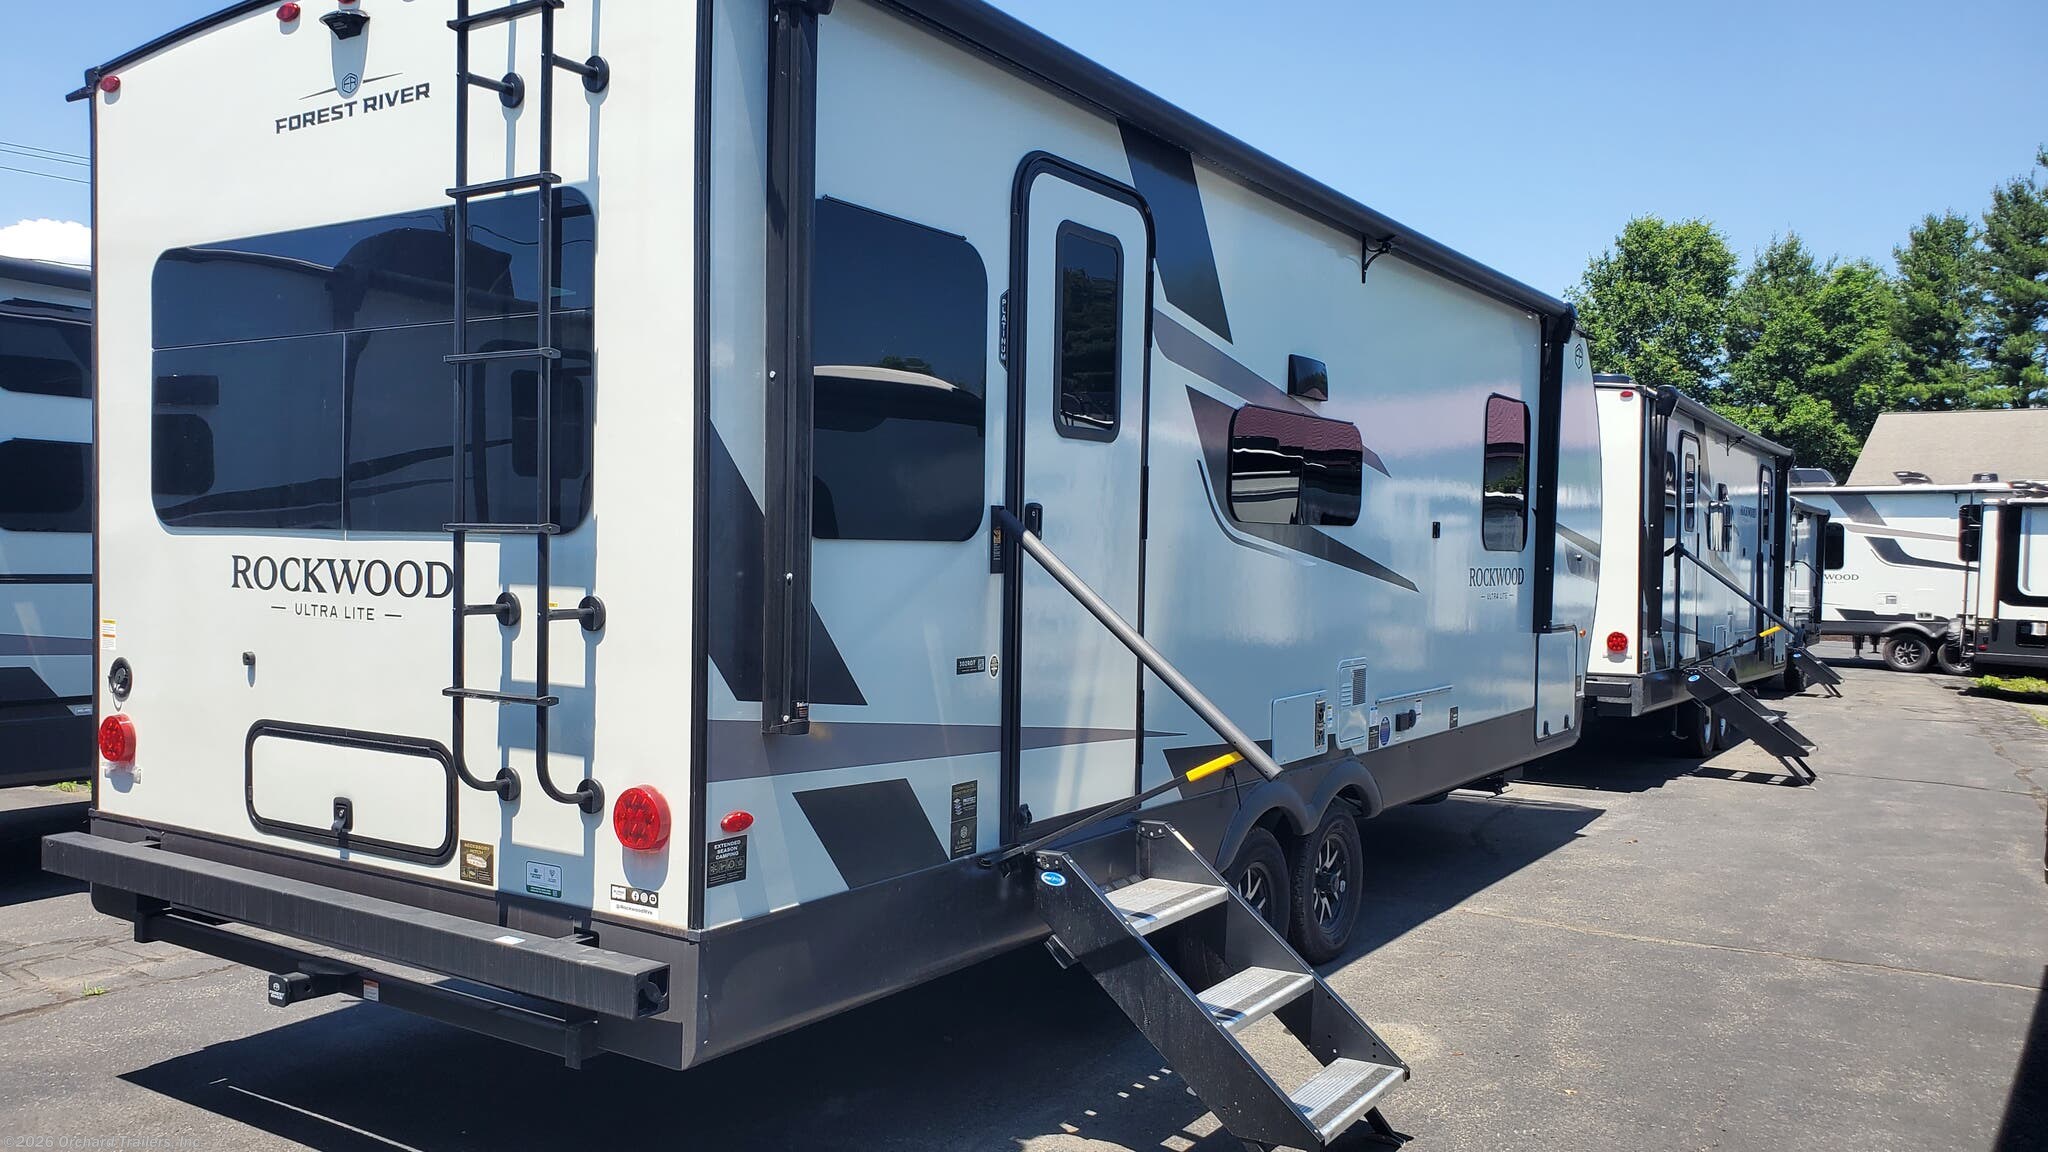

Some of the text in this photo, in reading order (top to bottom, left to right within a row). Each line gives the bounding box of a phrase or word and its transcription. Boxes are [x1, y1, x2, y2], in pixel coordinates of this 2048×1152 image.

[275, 83, 430, 134] FOREST RIVER
[231, 555, 454, 599] ROCKWOOD
[1469, 567, 1525, 587] ROCKWOOD
[1824, 573, 1859, 581] WOOD
[295, 603, 375, 621] ULTRA LITE
[714, 840, 742, 850] EXTENDED
[716, 845, 739, 854] SEASON
[715, 850, 740, 860] CAMPING
